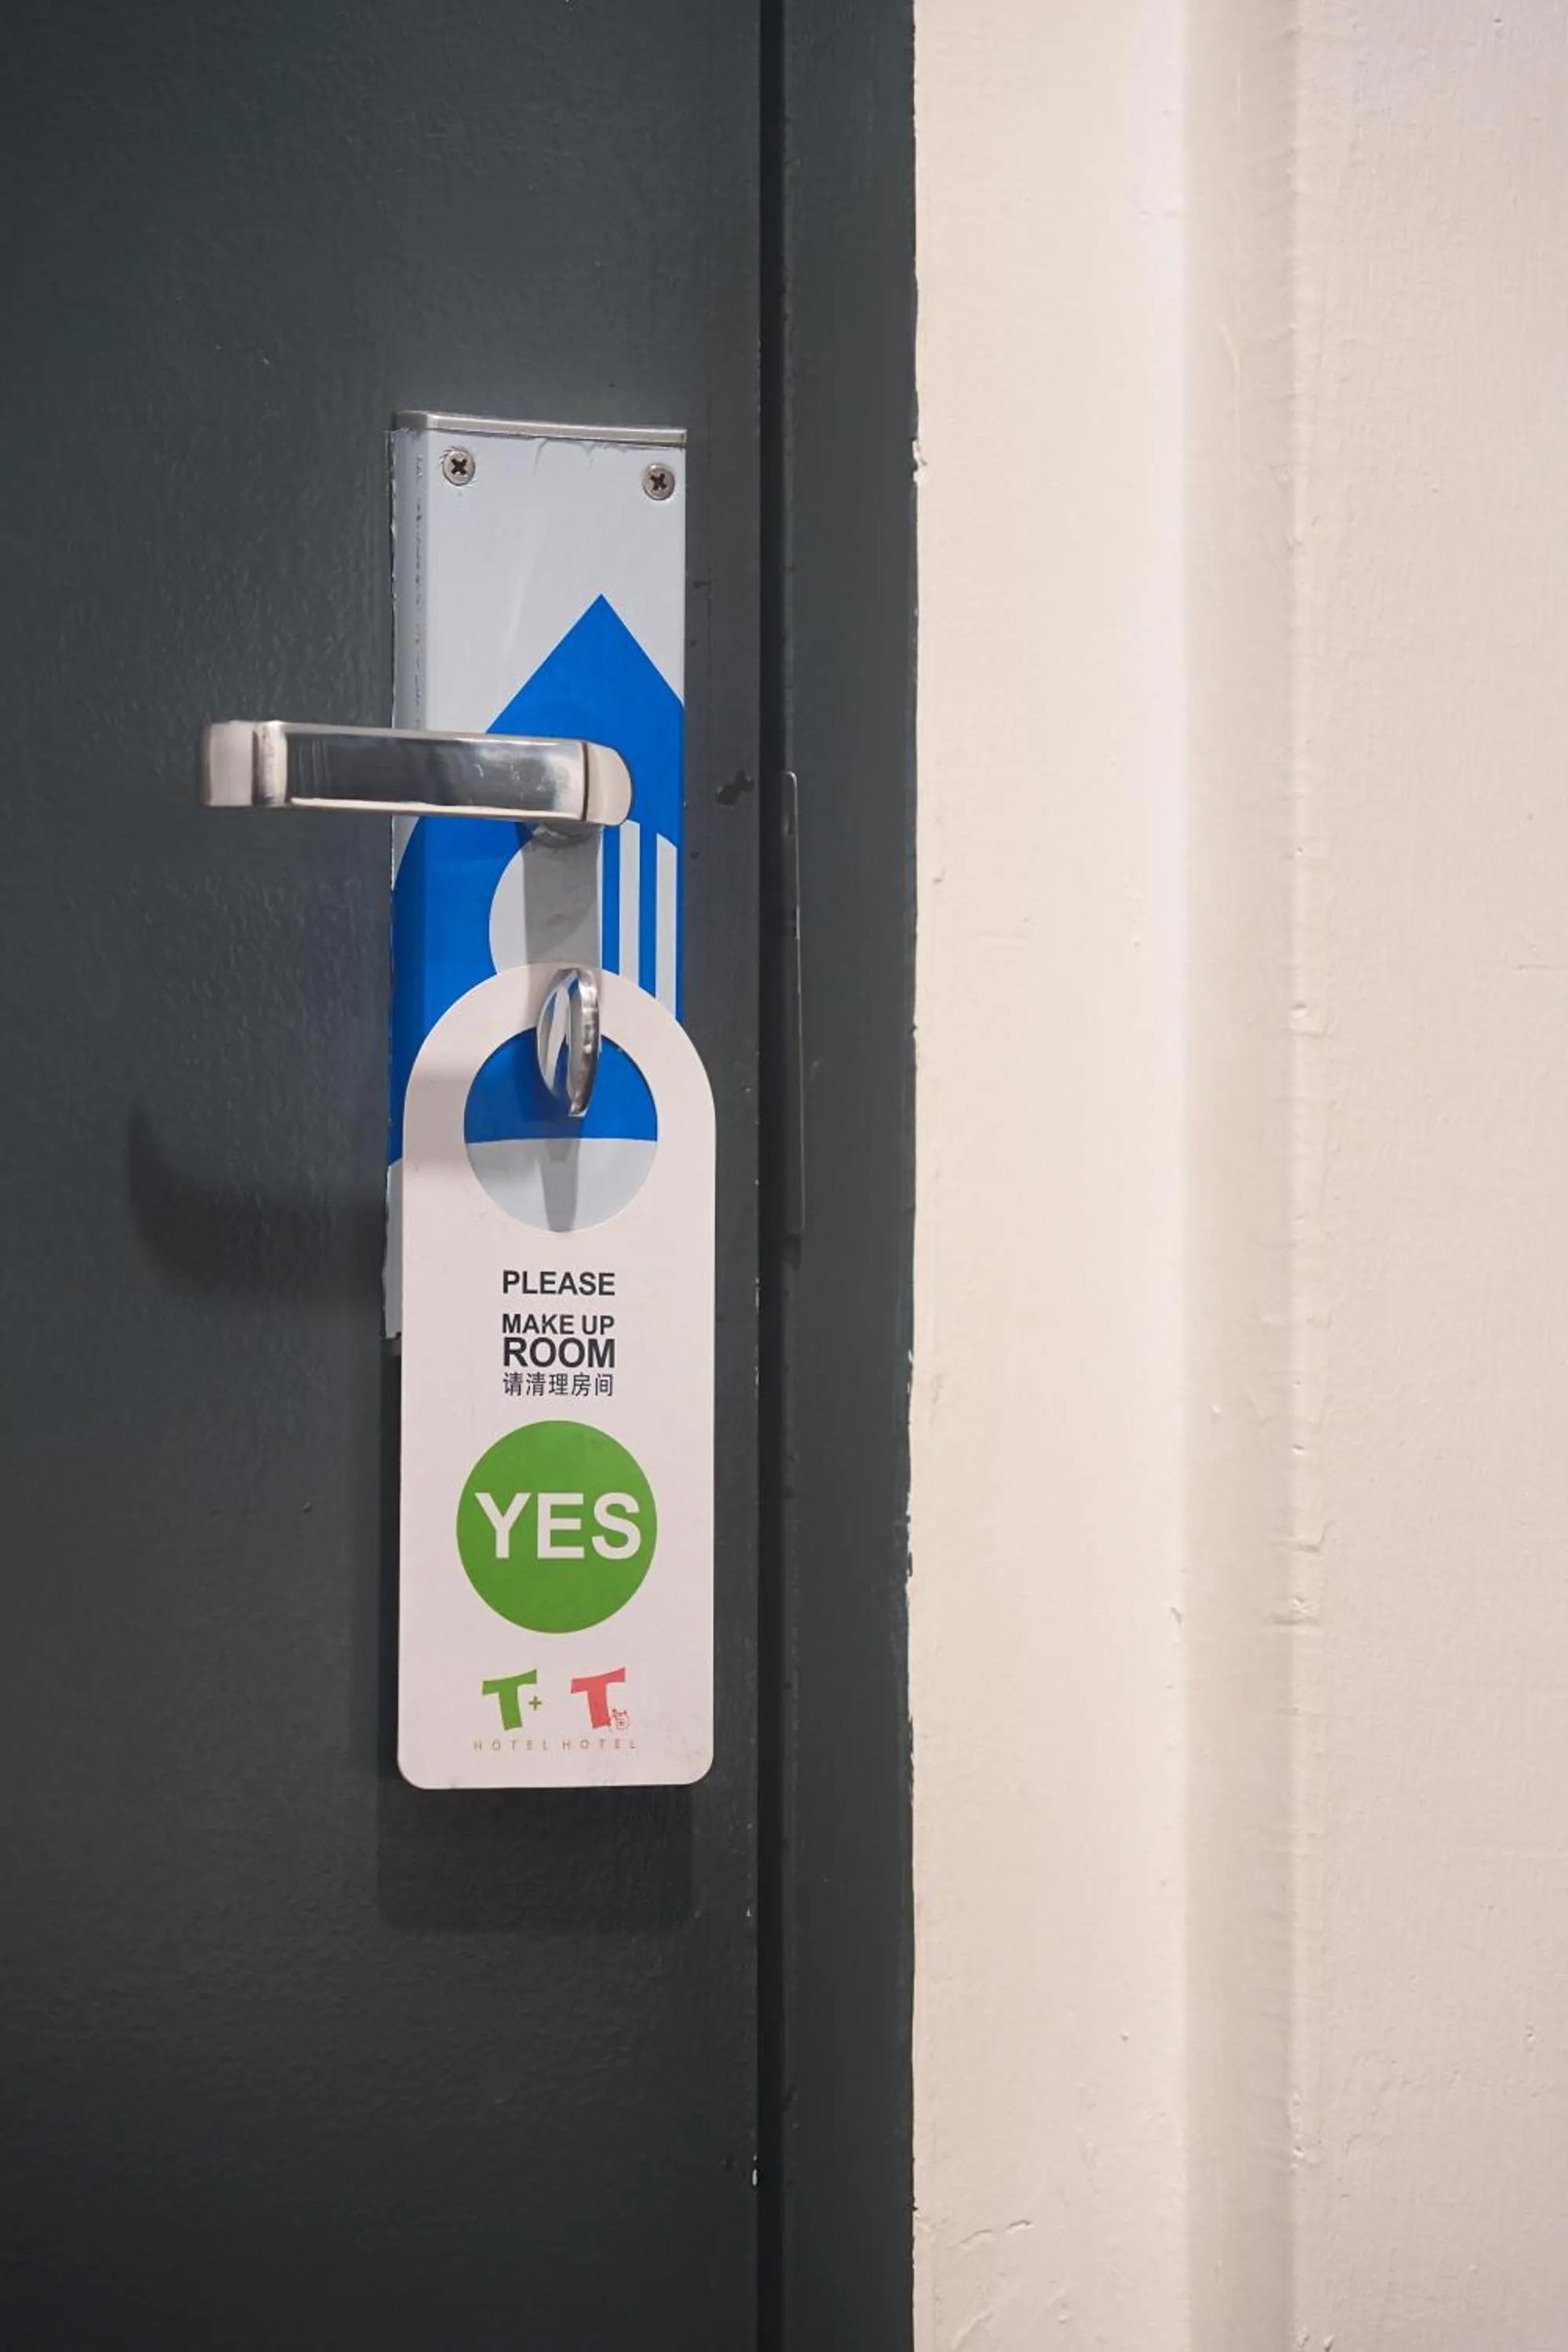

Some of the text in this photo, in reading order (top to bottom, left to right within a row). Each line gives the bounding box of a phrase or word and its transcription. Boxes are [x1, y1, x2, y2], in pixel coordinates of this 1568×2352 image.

[503, 1269, 615, 1296] PLEASE
[503, 1313, 615, 1335] MAKE UP
[503, 1336, 615, 1368] ROOM
[503, 1372, 614, 1396] 请清理房间
[474, 1492, 642, 1559] YES
[474, 1740, 548, 1751] HOTEL
[561, 1738, 637, 1749] HOTEL
